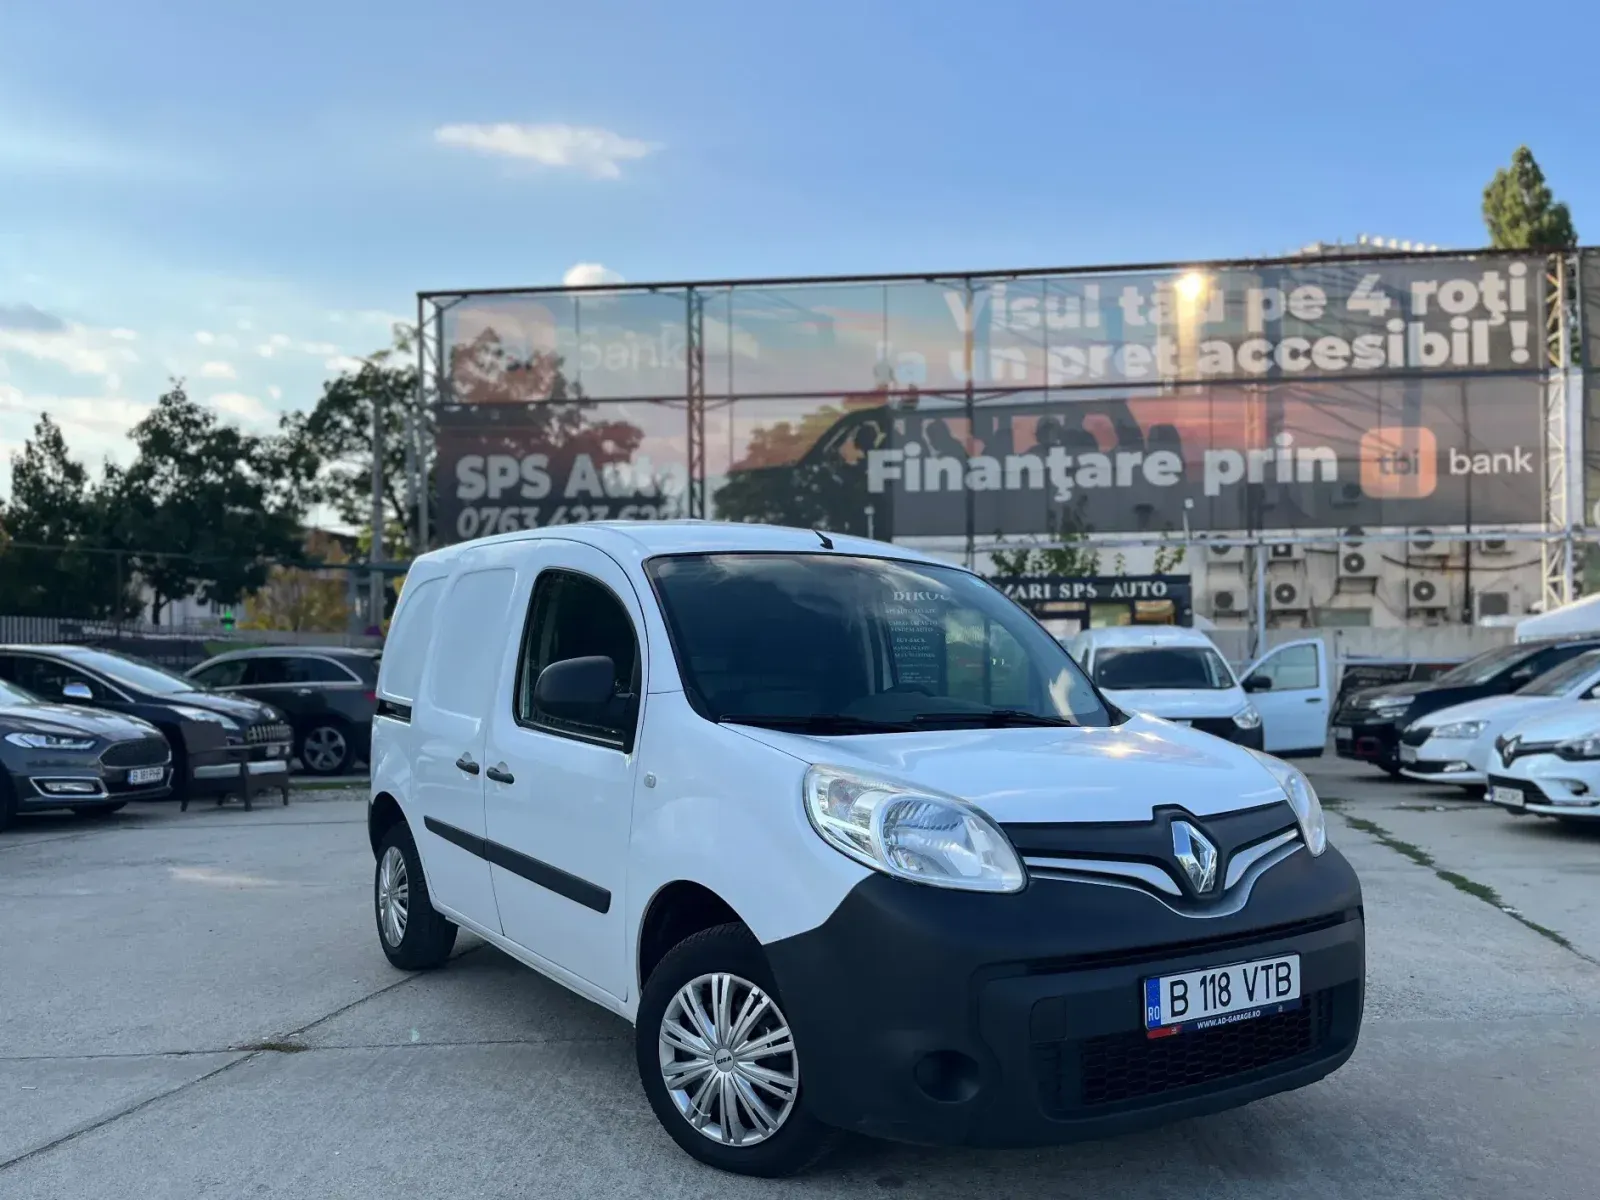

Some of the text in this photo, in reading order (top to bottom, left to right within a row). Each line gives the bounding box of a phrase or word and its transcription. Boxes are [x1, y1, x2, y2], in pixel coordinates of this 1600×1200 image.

[944, 284, 1100, 331] Visul
[1248, 285, 1327, 333] pe
[1347, 274, 1391, 316] 4
[950, 346, 1028, 381] un
[1199, 317, 1489, 373] accesibil
[456, 453, 686, 500] SPS Auto
[1203, 432, 1338, 497] prin
[1377, 447, 1419, 476] tbi
[1449, 446, 1534, 475] bank
[456, 506, 540, 538] 0763
[1059, 582, 1098, 598] SPS
[1111, 581, 1168, 598] AUTO
[1169, 961, 1292, 1018] B 118 VTB
[1147, 1006, 1161, 1022] RO
[1197, 1010, 1261, 1030] WWW.AD-GARAGE.RO
